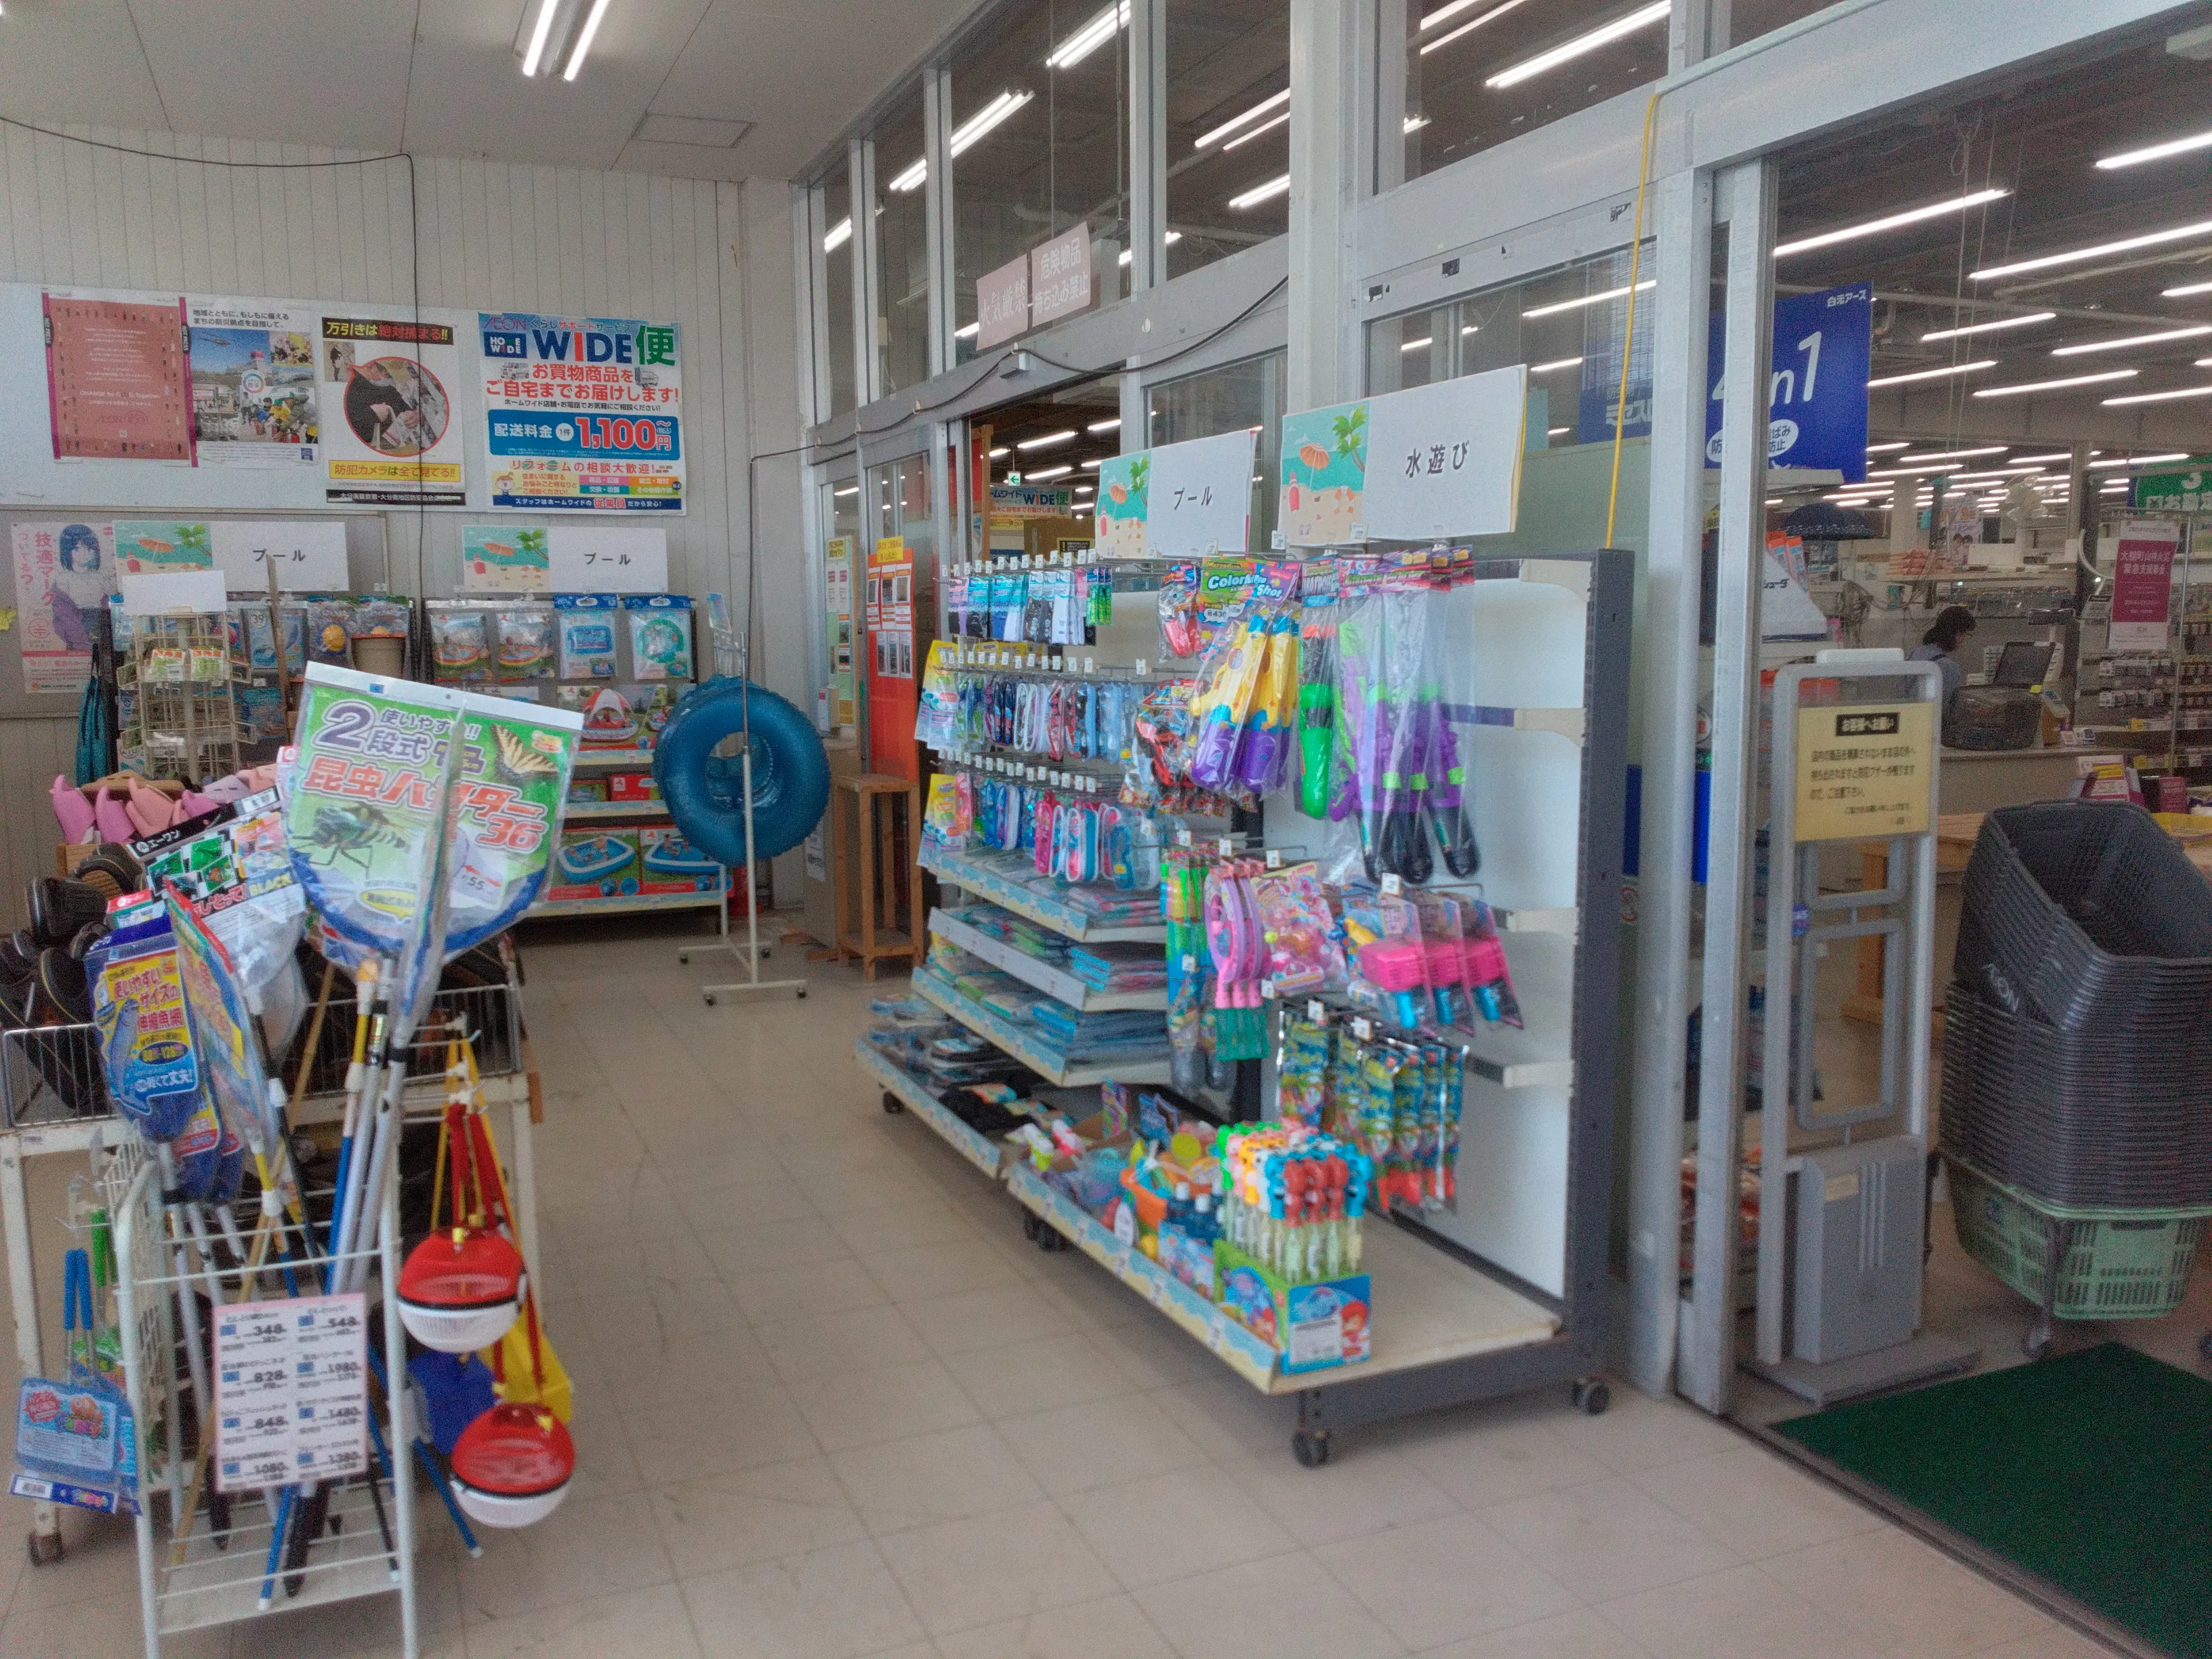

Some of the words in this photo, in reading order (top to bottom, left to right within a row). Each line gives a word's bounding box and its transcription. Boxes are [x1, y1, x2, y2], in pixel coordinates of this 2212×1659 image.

[532, 363, 634, 384] お買物商品を
[493, 422, 553, 438] 配送料金
[575, 416, 657, 451] 1,100
[1406, 439, 1470, 478] 水遊び
[1173, 485, 1213, 511] プール
[253, 549, 306, 563] プール
[583, 552, 632, 567] プール
[380, 708, 482, 740] 使いやす!!
[480, 817, 544, 850] 36
